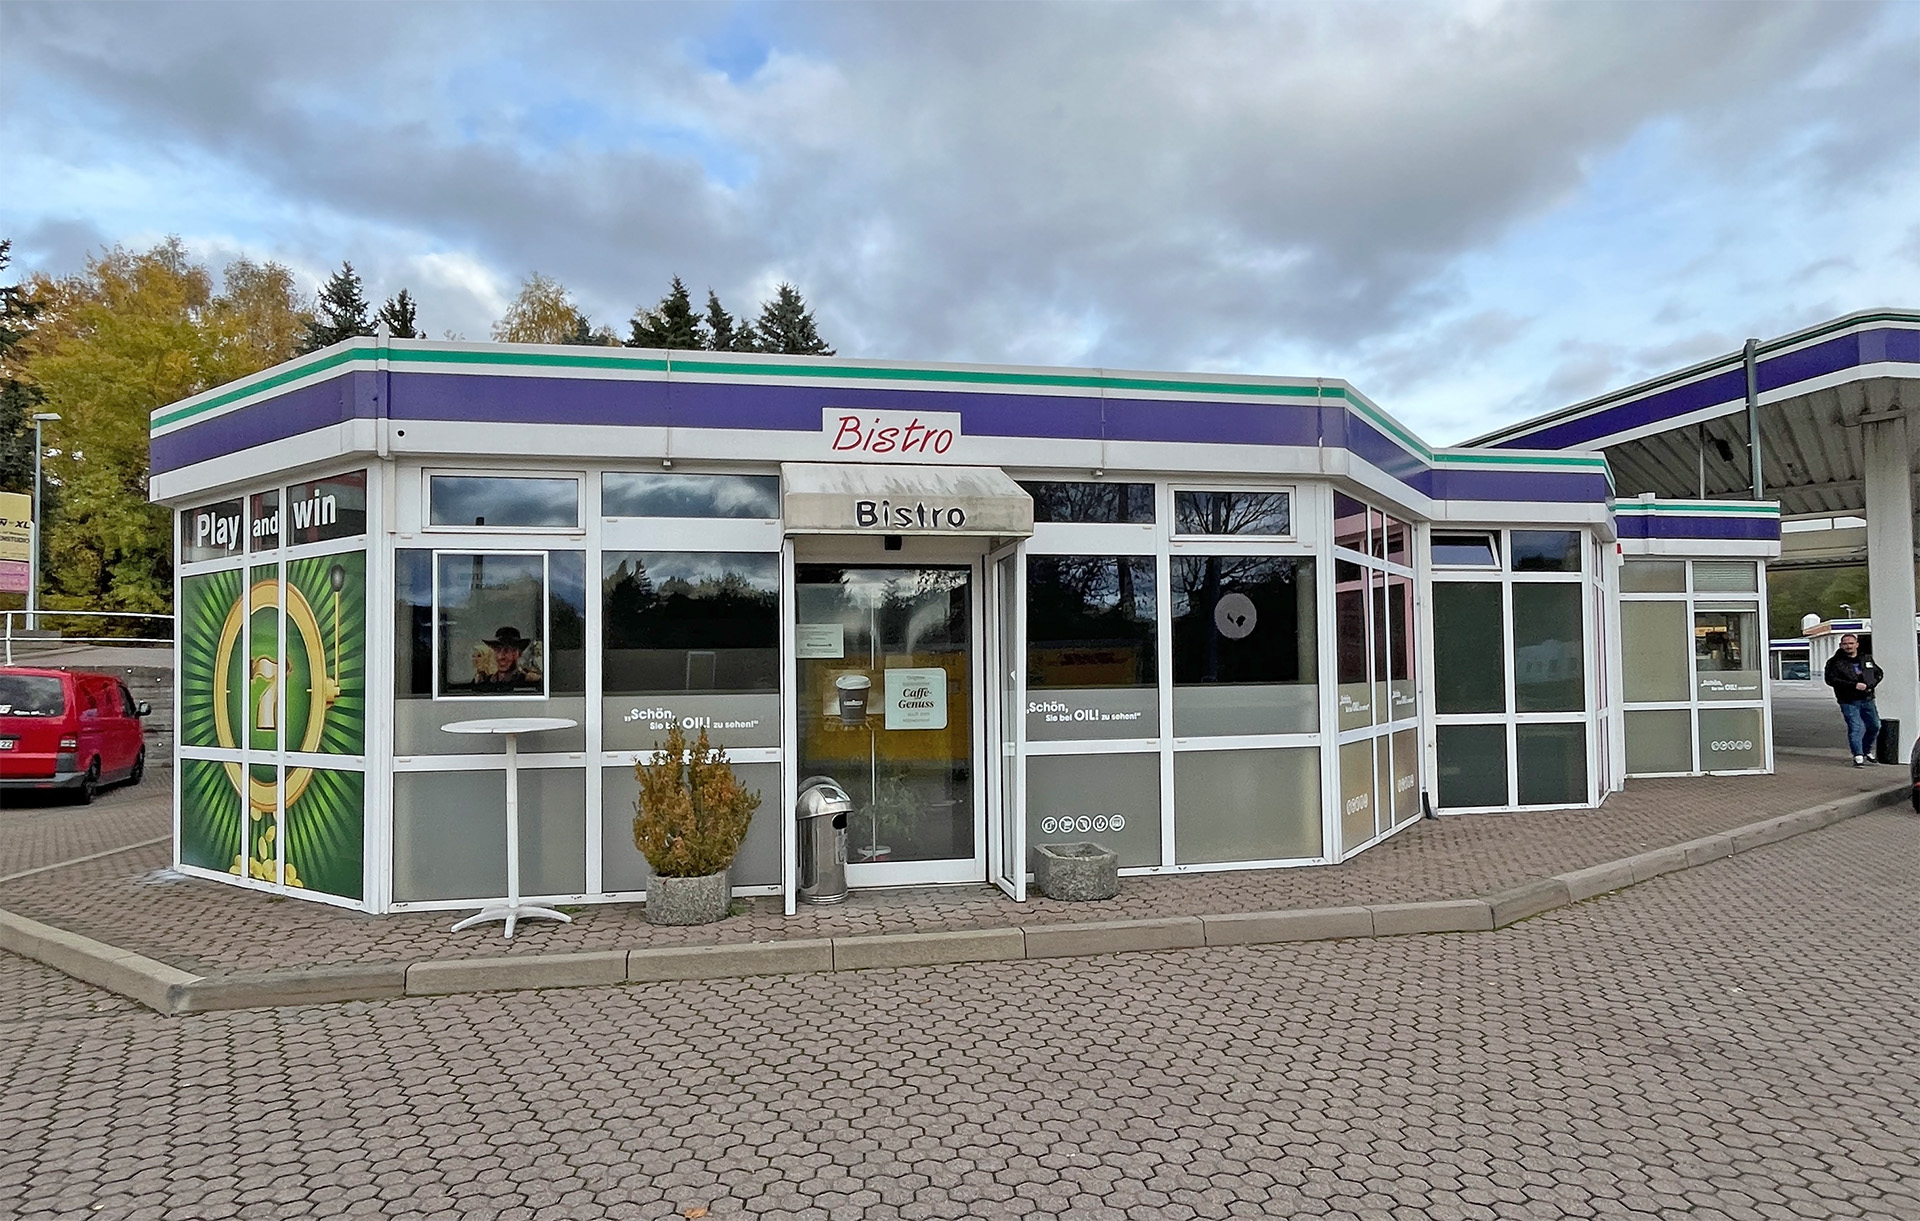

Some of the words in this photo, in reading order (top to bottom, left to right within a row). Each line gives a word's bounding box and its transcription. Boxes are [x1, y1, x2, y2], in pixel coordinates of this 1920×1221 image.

[832, 415, 953, 454] Bistro
[196, 511, 241, 551] Play
[252, 510, 279, 537] and
[292, 488, 337, 530] win
[855, 499, 967, 529] Bistro
[15, 520, 30, 529] XL
[898, 699, 934, 709] Genuss
[624, 707, 677, 722] „Schön,
[1074, 709, 1099, 721] OIL!
[1101, 713, 1110, 721] zu
[682, 716, 710, 729] OIL!
[713, 721, 723, 729] zu
